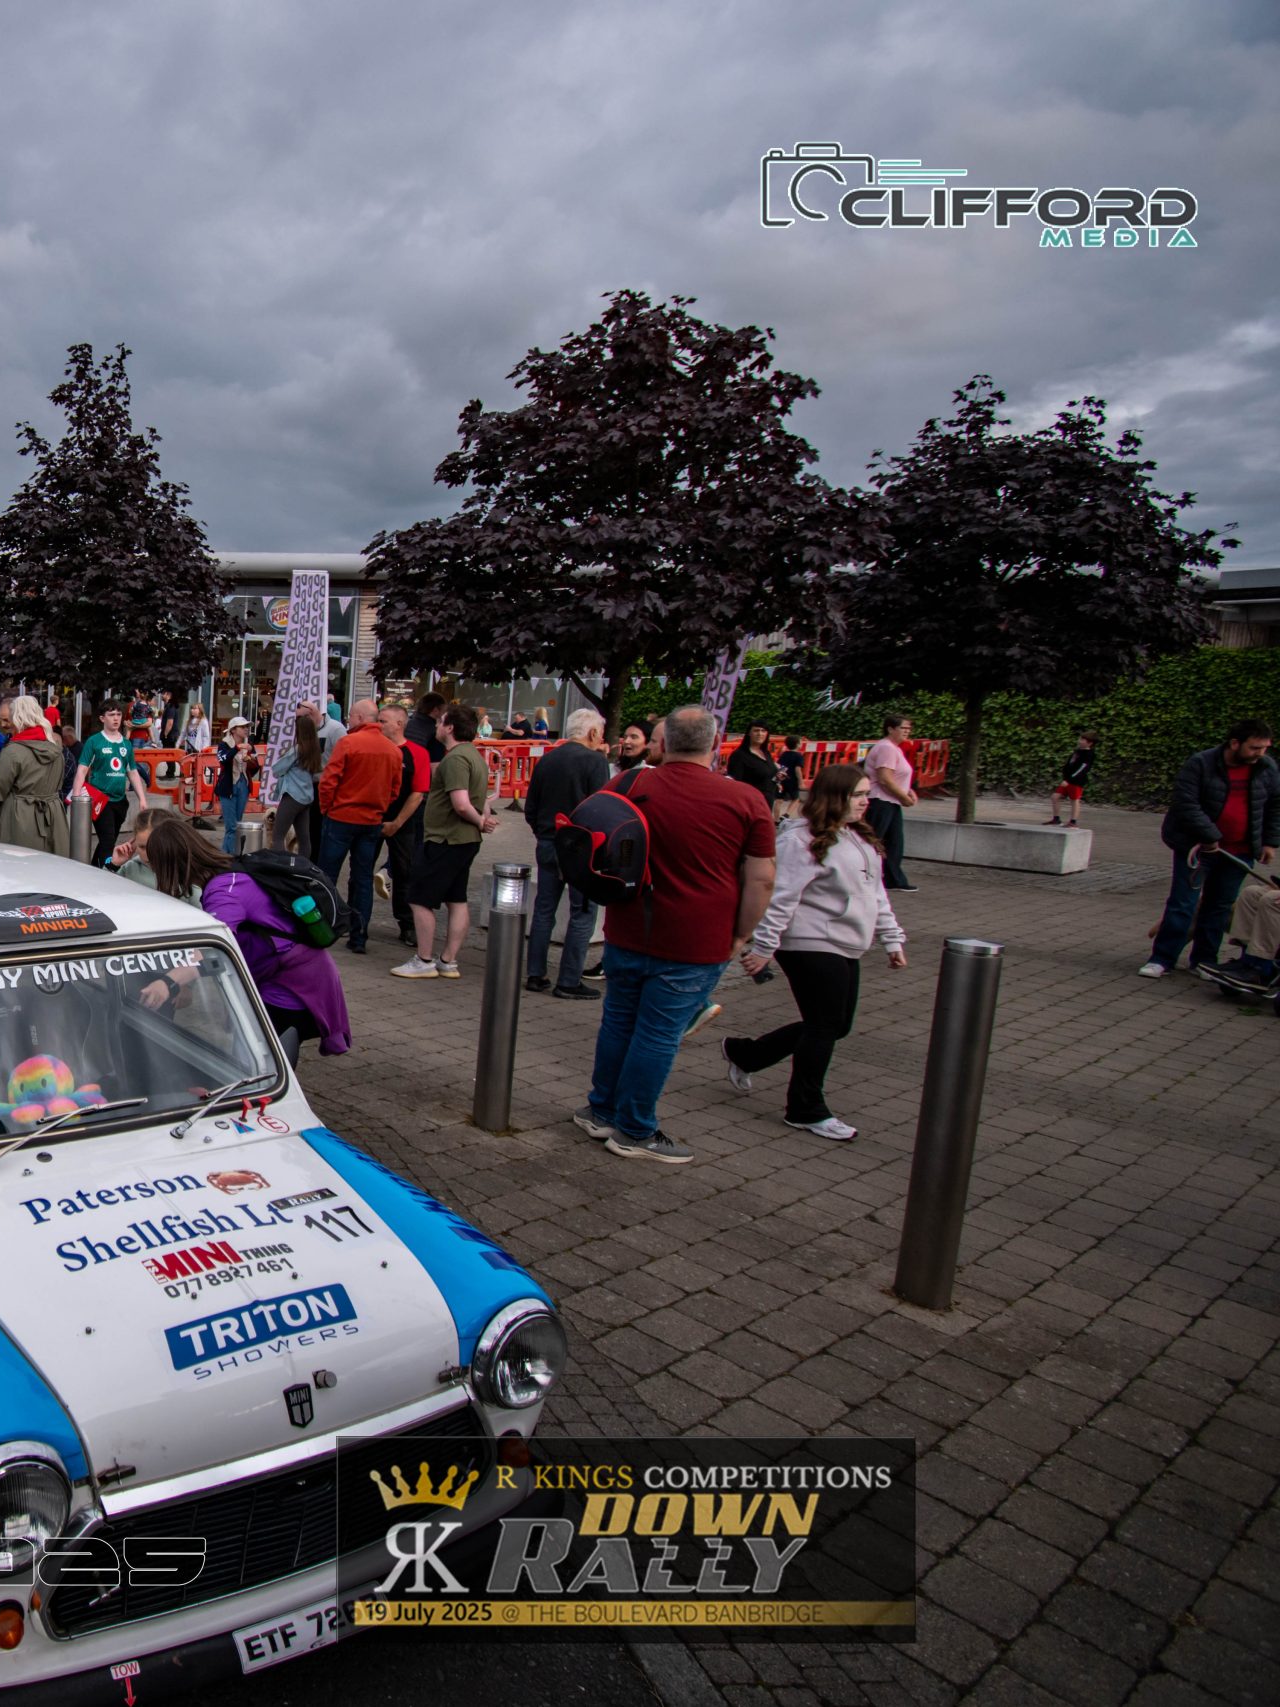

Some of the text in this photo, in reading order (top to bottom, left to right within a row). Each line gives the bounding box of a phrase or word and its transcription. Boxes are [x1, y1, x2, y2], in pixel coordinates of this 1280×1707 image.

[271, 610, 289, 623] KIN
[20, 918, 88, 935] MINIRU
[41, 904, 68, 912] MINI
[44, 910, 69, 919] SPORT
[32, 960, 100, 987] MINI
[105, 948, 201, 977] CENTRE
[19, 1172, 207, 1226] Paterson
[55, 1206, 243, 1273] Shellfish
[239, 1202, 295, 1228] Lt
[304, 1205, 375, 1243] 117
[152, 1241, 244, 1281] MINI
[238, 1243, 294, 1261] THING
[179, 1290, 341, 1358] TRITON
[193, 1323, 359, 1381] SHOWERS
[288, 1387, 309, 1406] MINI
[243, 1622, 298, 1662] ETF
[112, 1661, 138, 1678] TOW
